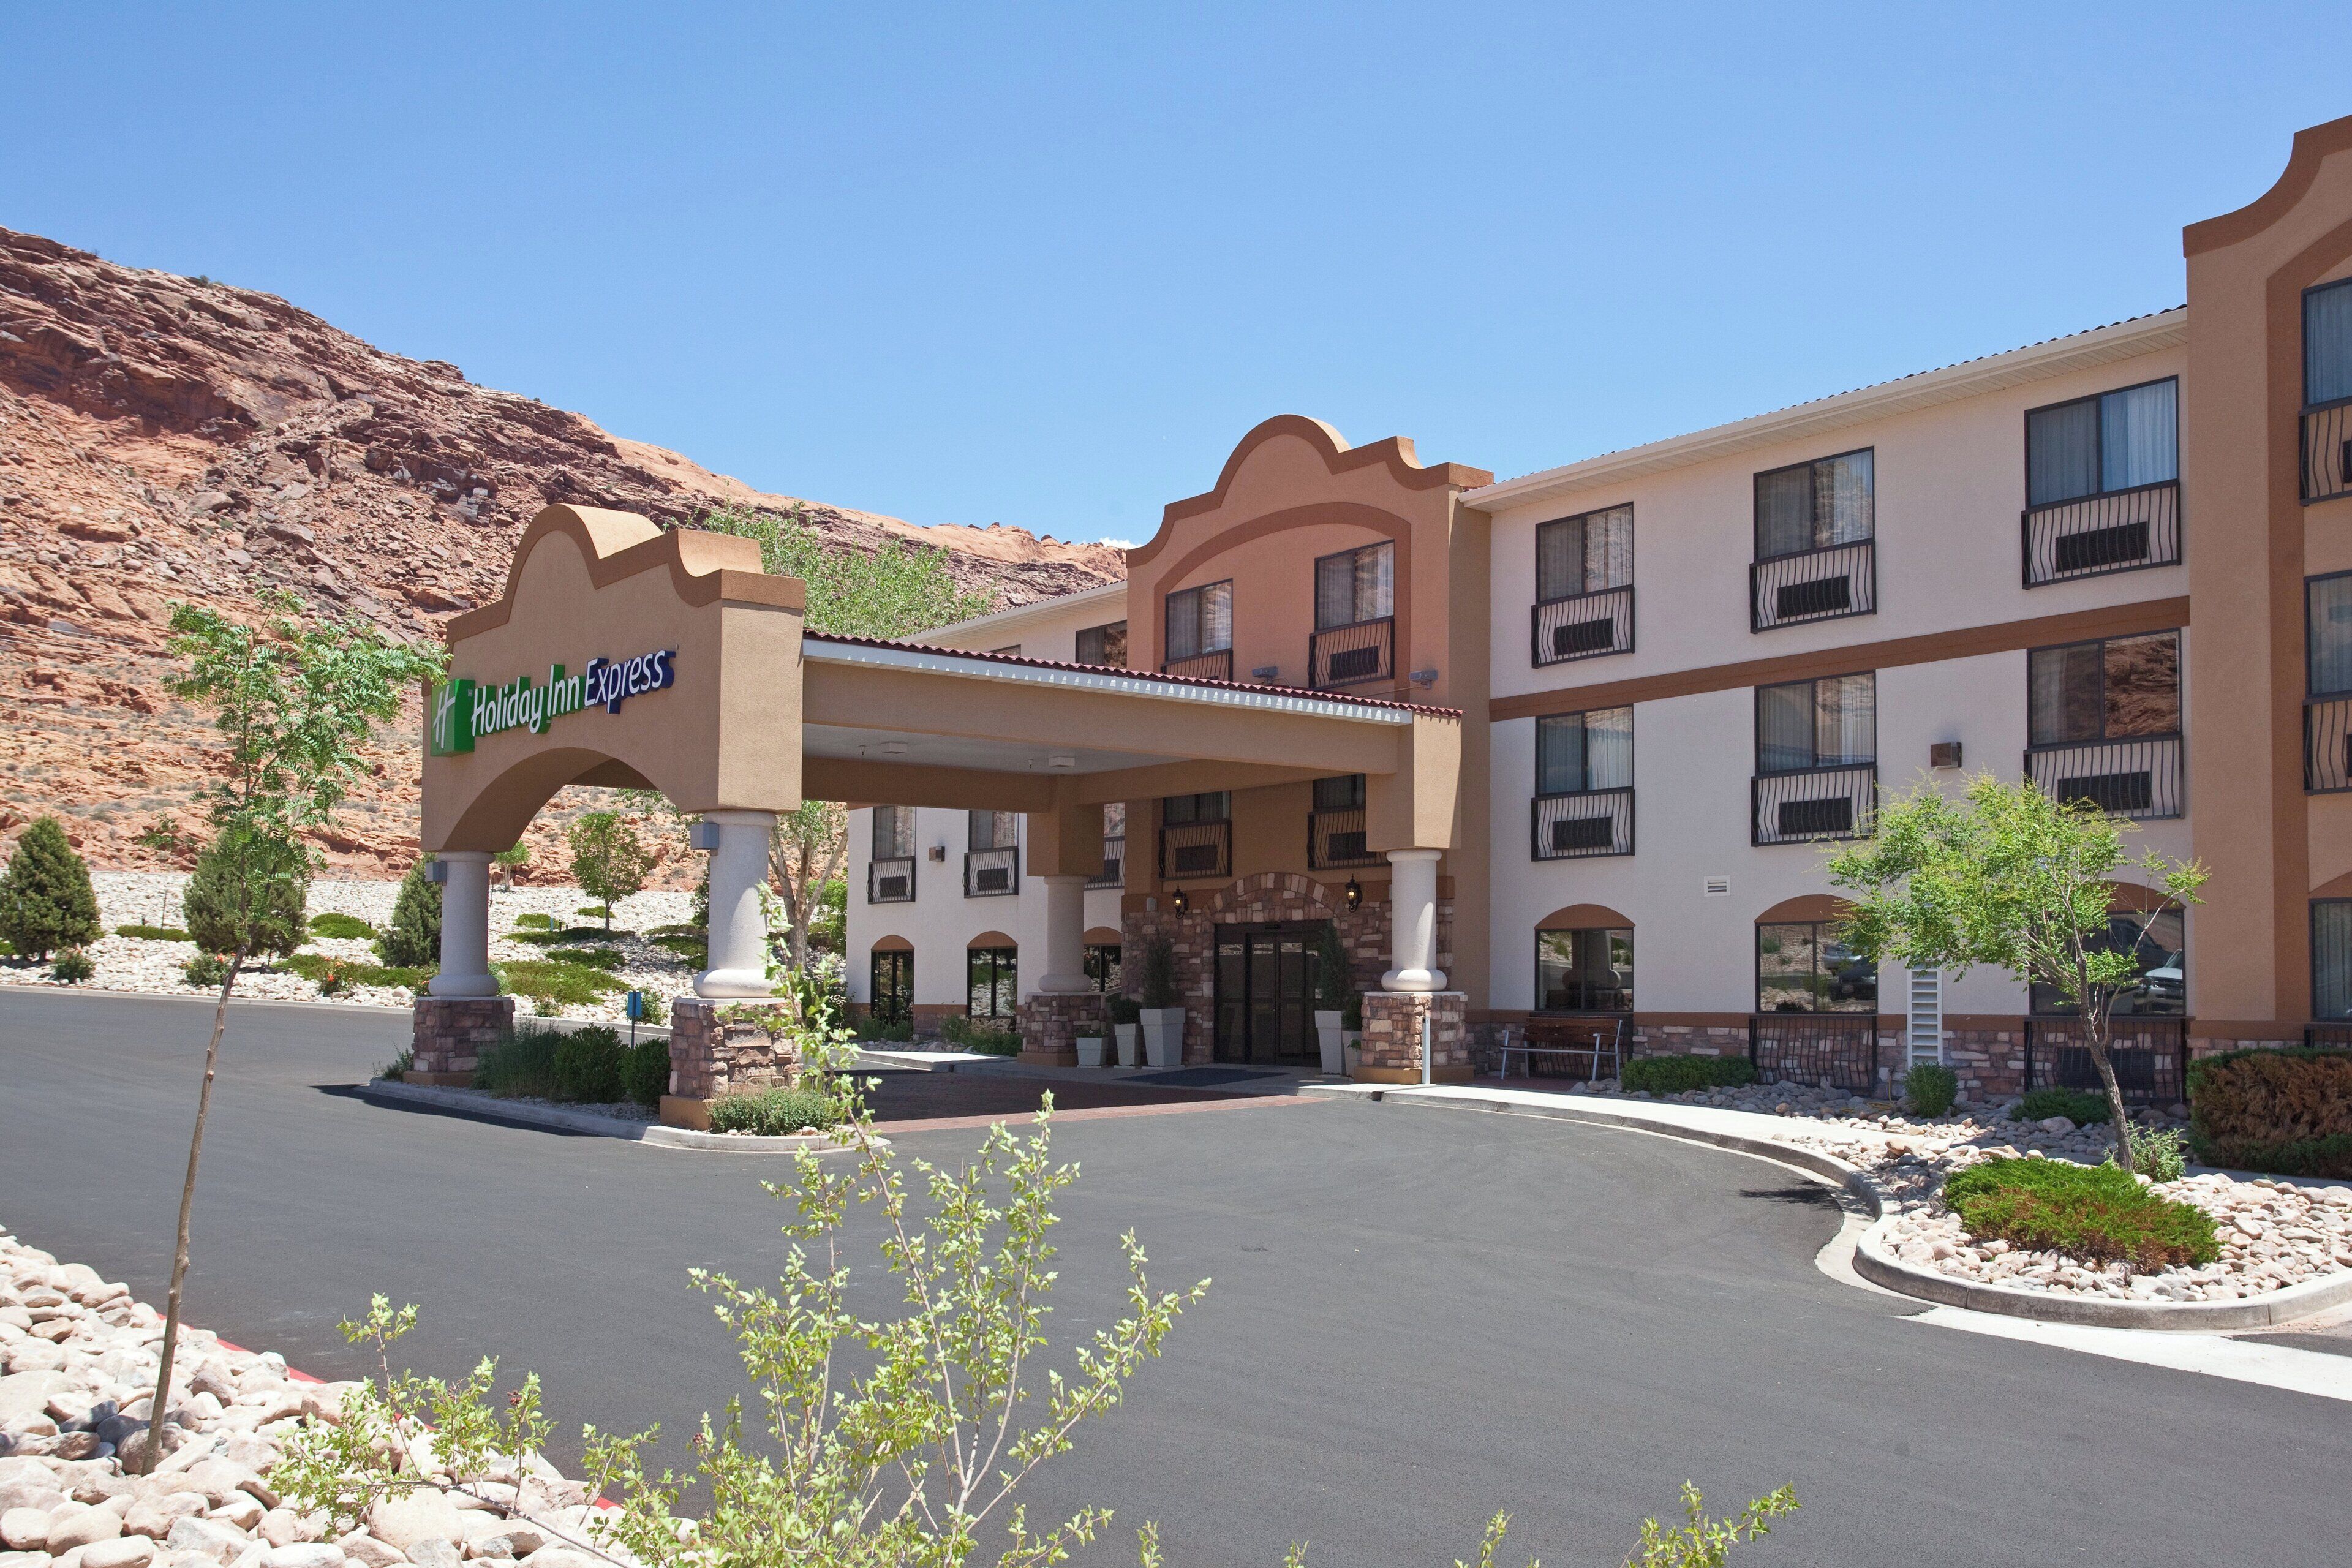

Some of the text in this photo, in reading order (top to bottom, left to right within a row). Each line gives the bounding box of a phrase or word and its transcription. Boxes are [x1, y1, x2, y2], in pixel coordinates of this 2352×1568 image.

[471, 650, 665, 737] Holiday Inn Express
